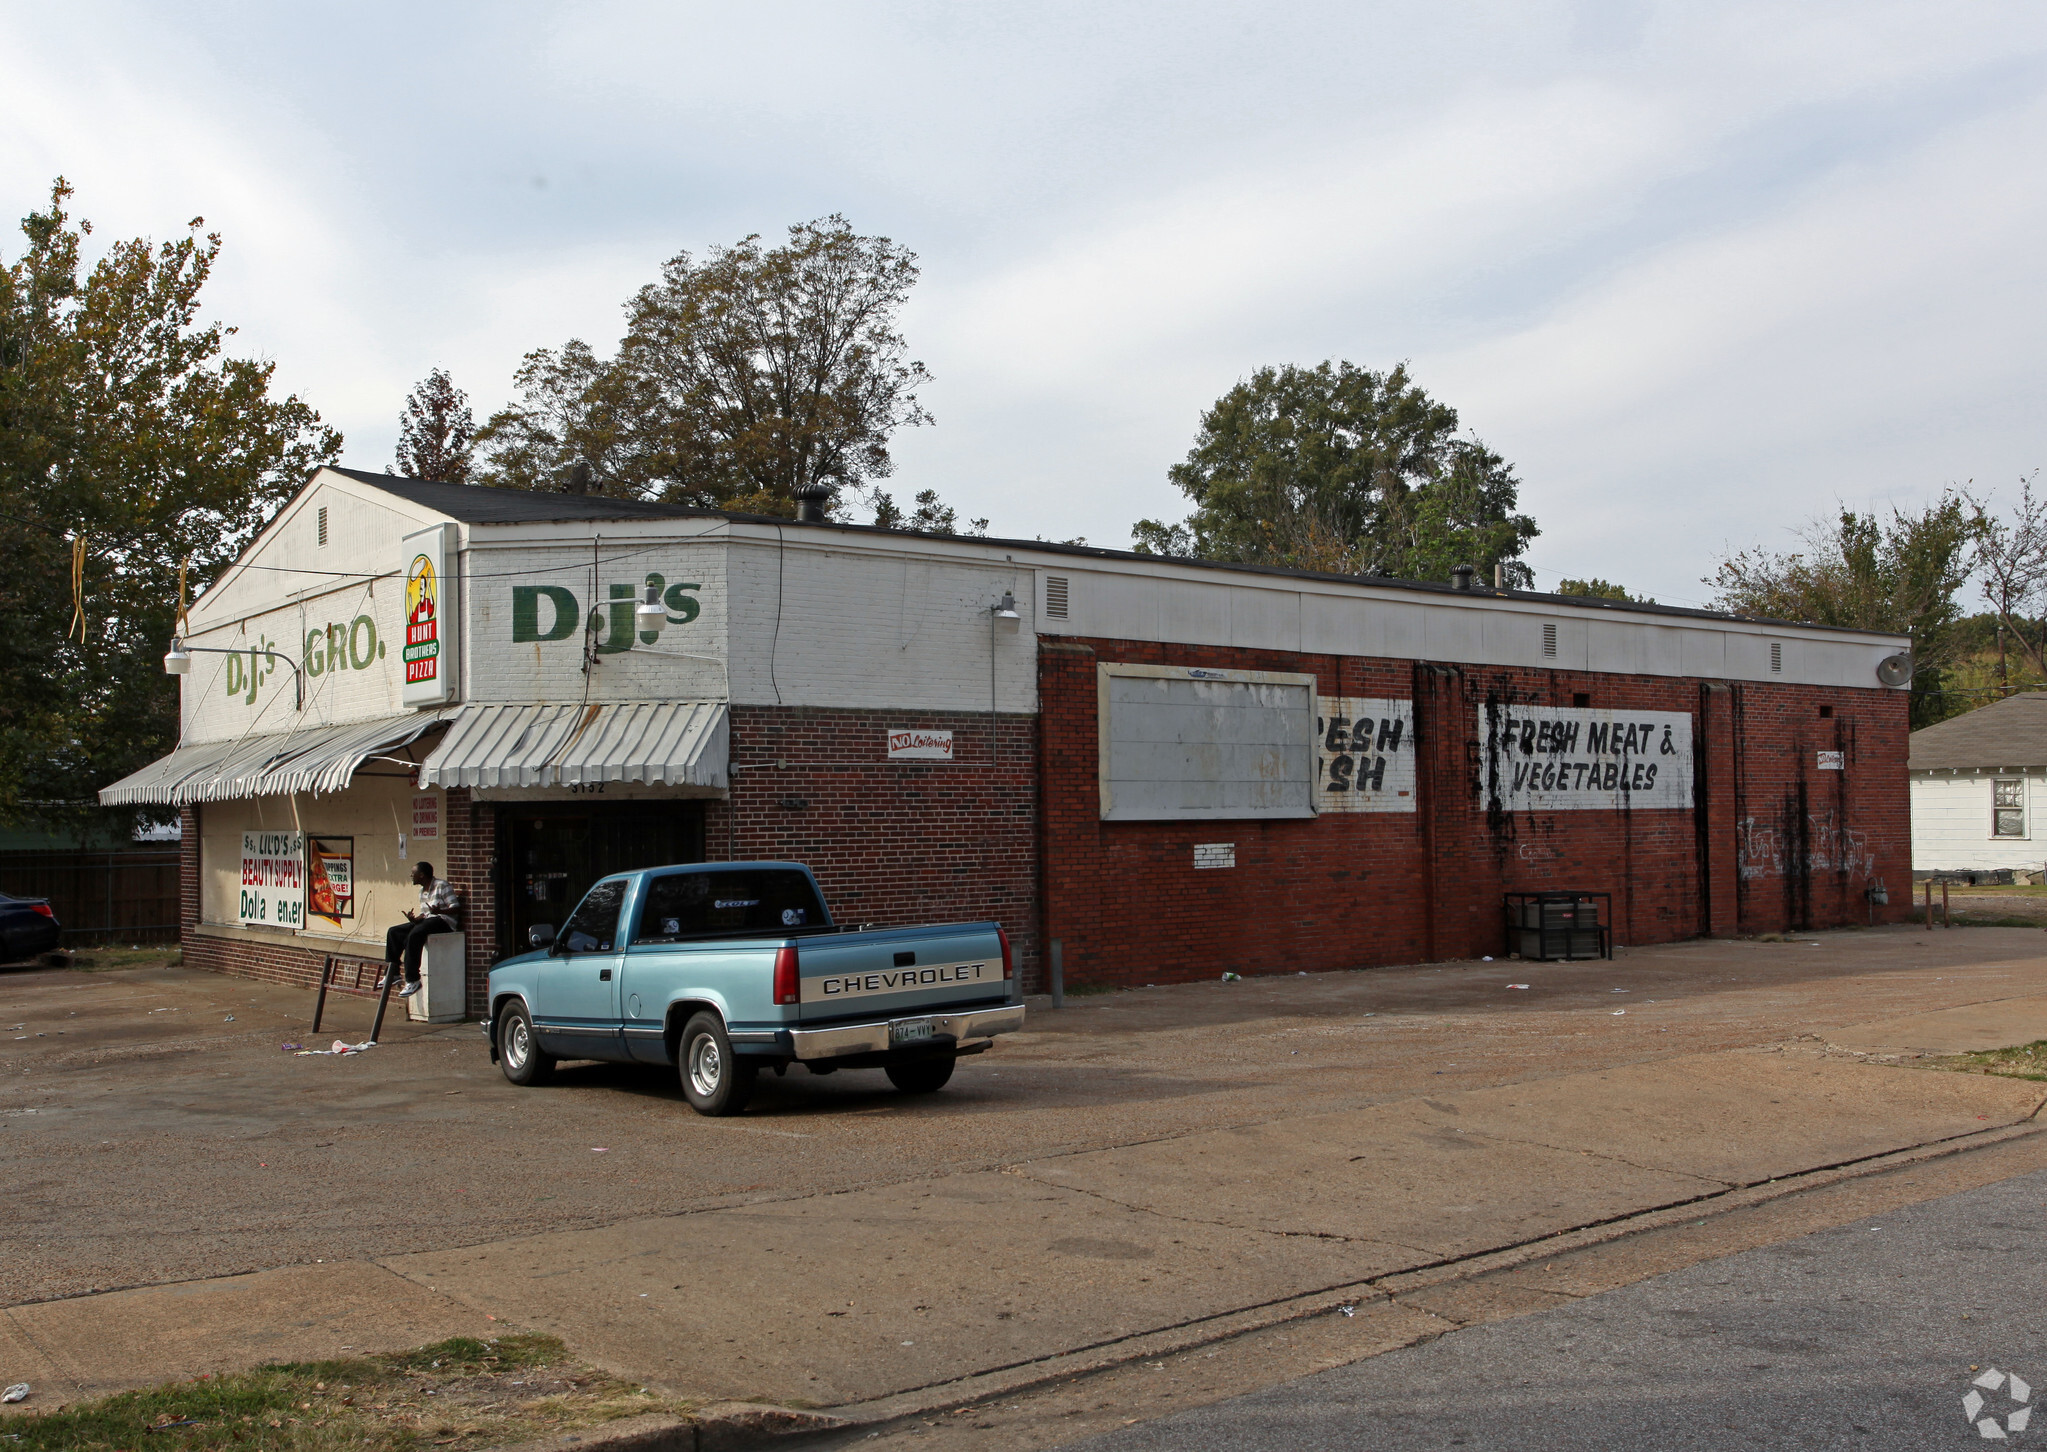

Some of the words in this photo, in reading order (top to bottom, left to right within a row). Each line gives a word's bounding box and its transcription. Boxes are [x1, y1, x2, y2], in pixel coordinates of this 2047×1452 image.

[411, 623, 432, 643] HUNT
[306, 614, 386, 678] GRO.
[405, 642, 437, 661] BROTHERS
[409, 660, 434, 680] PIZZA
[891, 734, 911, 751] NO
[912, 735, 952, 753] Loitering
[1503, 720, 1579, 754] FRESH
[1587, 722, 1655, 754] MEAT
[1660, 724, 1676, 755] &
[1513, 761, 1658, 792] VEGETABLES
[413, 798, 418, 809] NO
[419, 797, 437, 809] LOITERING
[413, 812, 418, 823] NO
[419, 811, 437, 823] DRINKING
[419, 827, 437, 836] PREMISES
[260, 834, 288, 855] LIL'D'S
[243, 859, 273, 887] BEAUTY
[275, 860, 302, 888] SUPPLY
[823, 963, 985, 995] CHEVROLET
